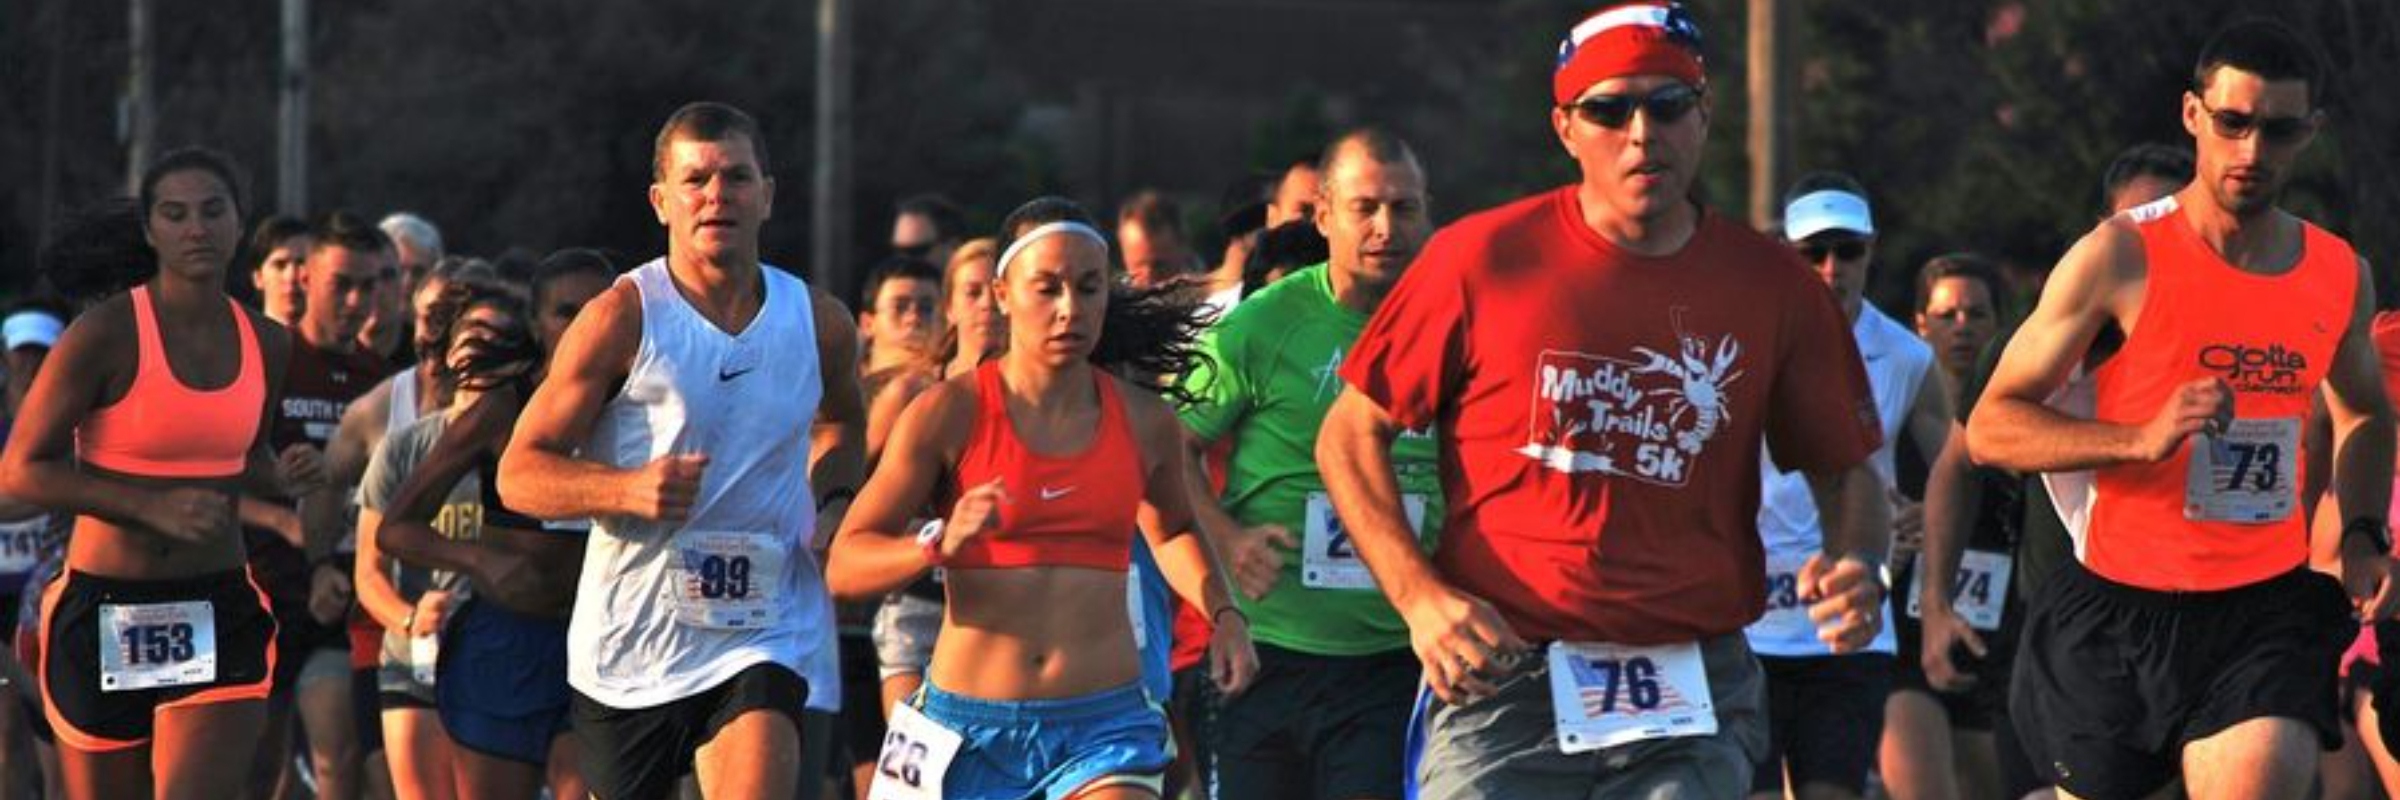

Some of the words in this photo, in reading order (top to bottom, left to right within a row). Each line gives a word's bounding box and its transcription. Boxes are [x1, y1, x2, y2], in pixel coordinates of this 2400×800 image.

[1541, 364, 1643, 410] Muddy
[2242, 368, 2297, 385] run
[283, 398, 332, 418] SOUTH
[1587, 399, 1669, 441] Trails
[2227, 442, 2280, 491] 73
[700, 554, 751, 599] 99
[122, 622, 195, 664] 153
[1591, 656, 1660, 712] 76
